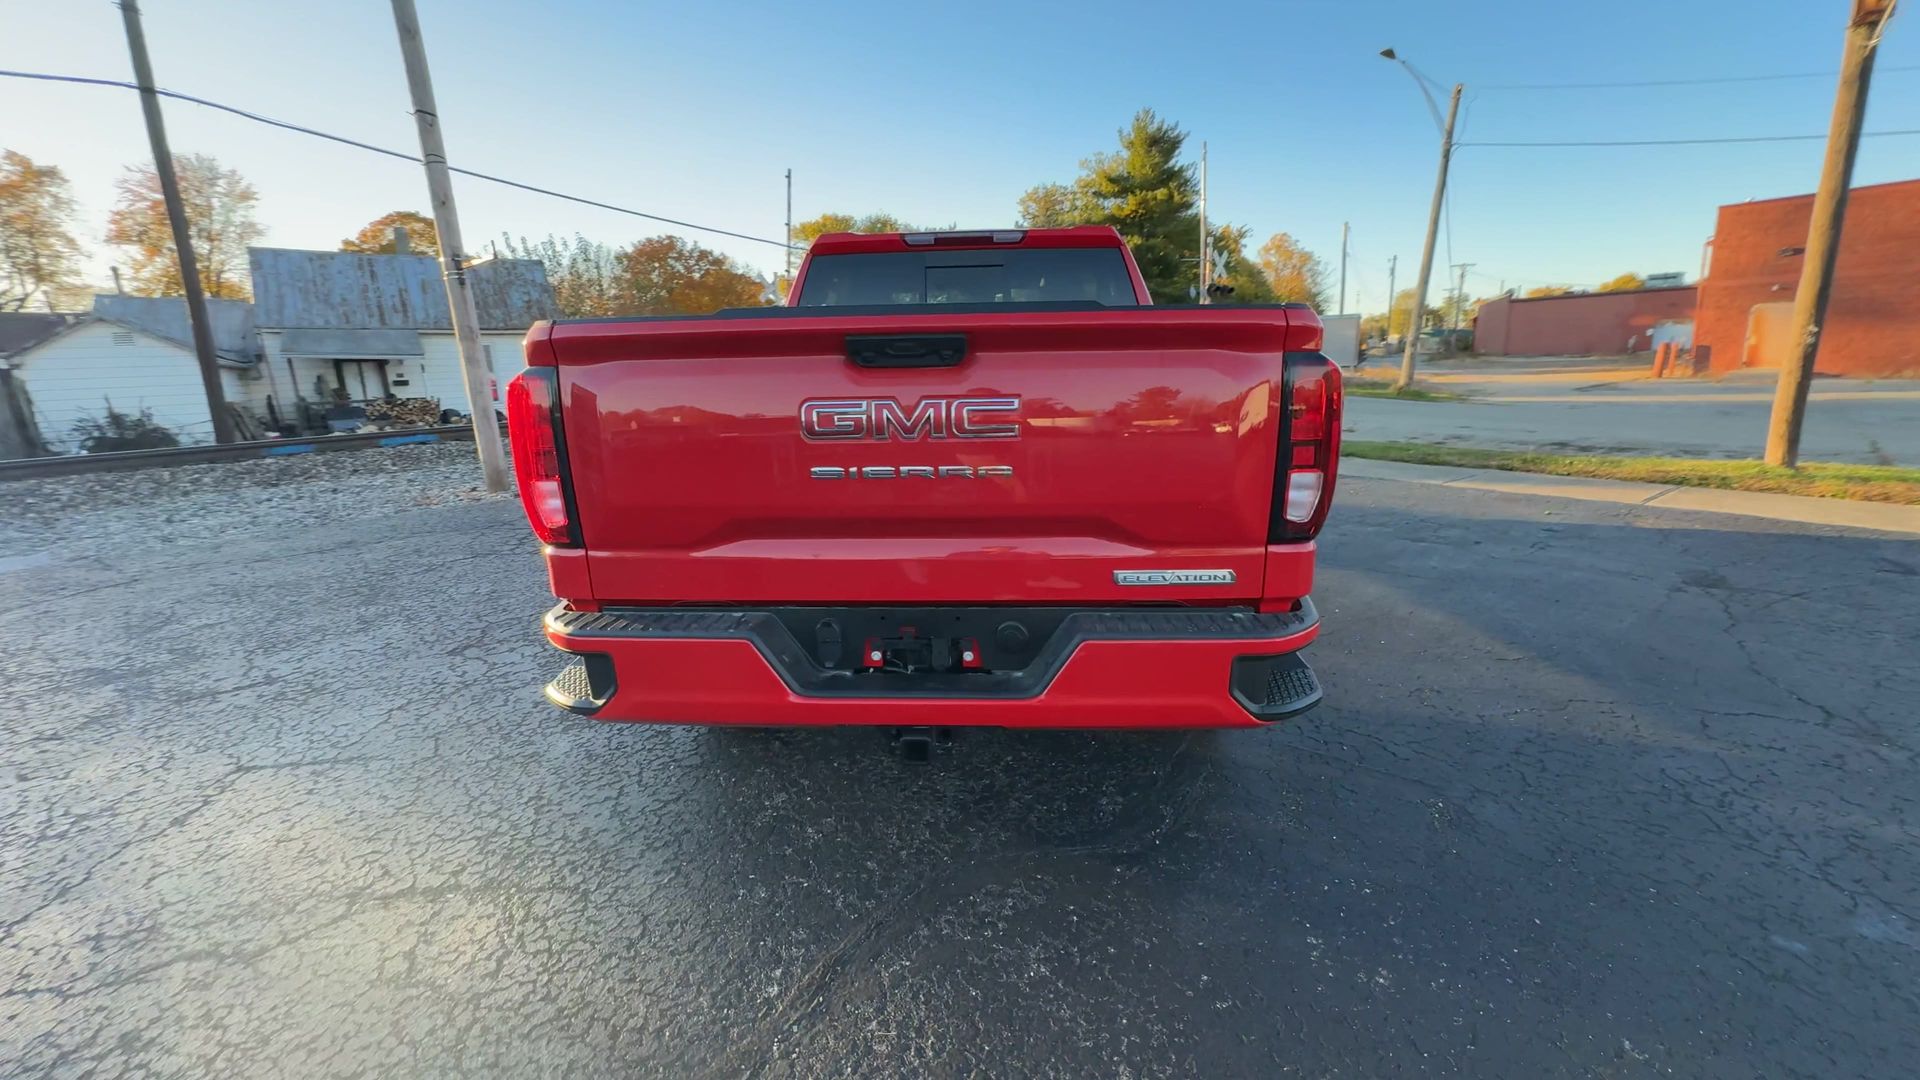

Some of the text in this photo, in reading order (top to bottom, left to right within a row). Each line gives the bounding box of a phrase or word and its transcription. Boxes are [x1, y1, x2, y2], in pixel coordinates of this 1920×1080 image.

[800, 398, 1020, 440] GMC
[810, 465, 1013, 479] SIERRA
[1122, 573, 1228, 583] ELEVATION
